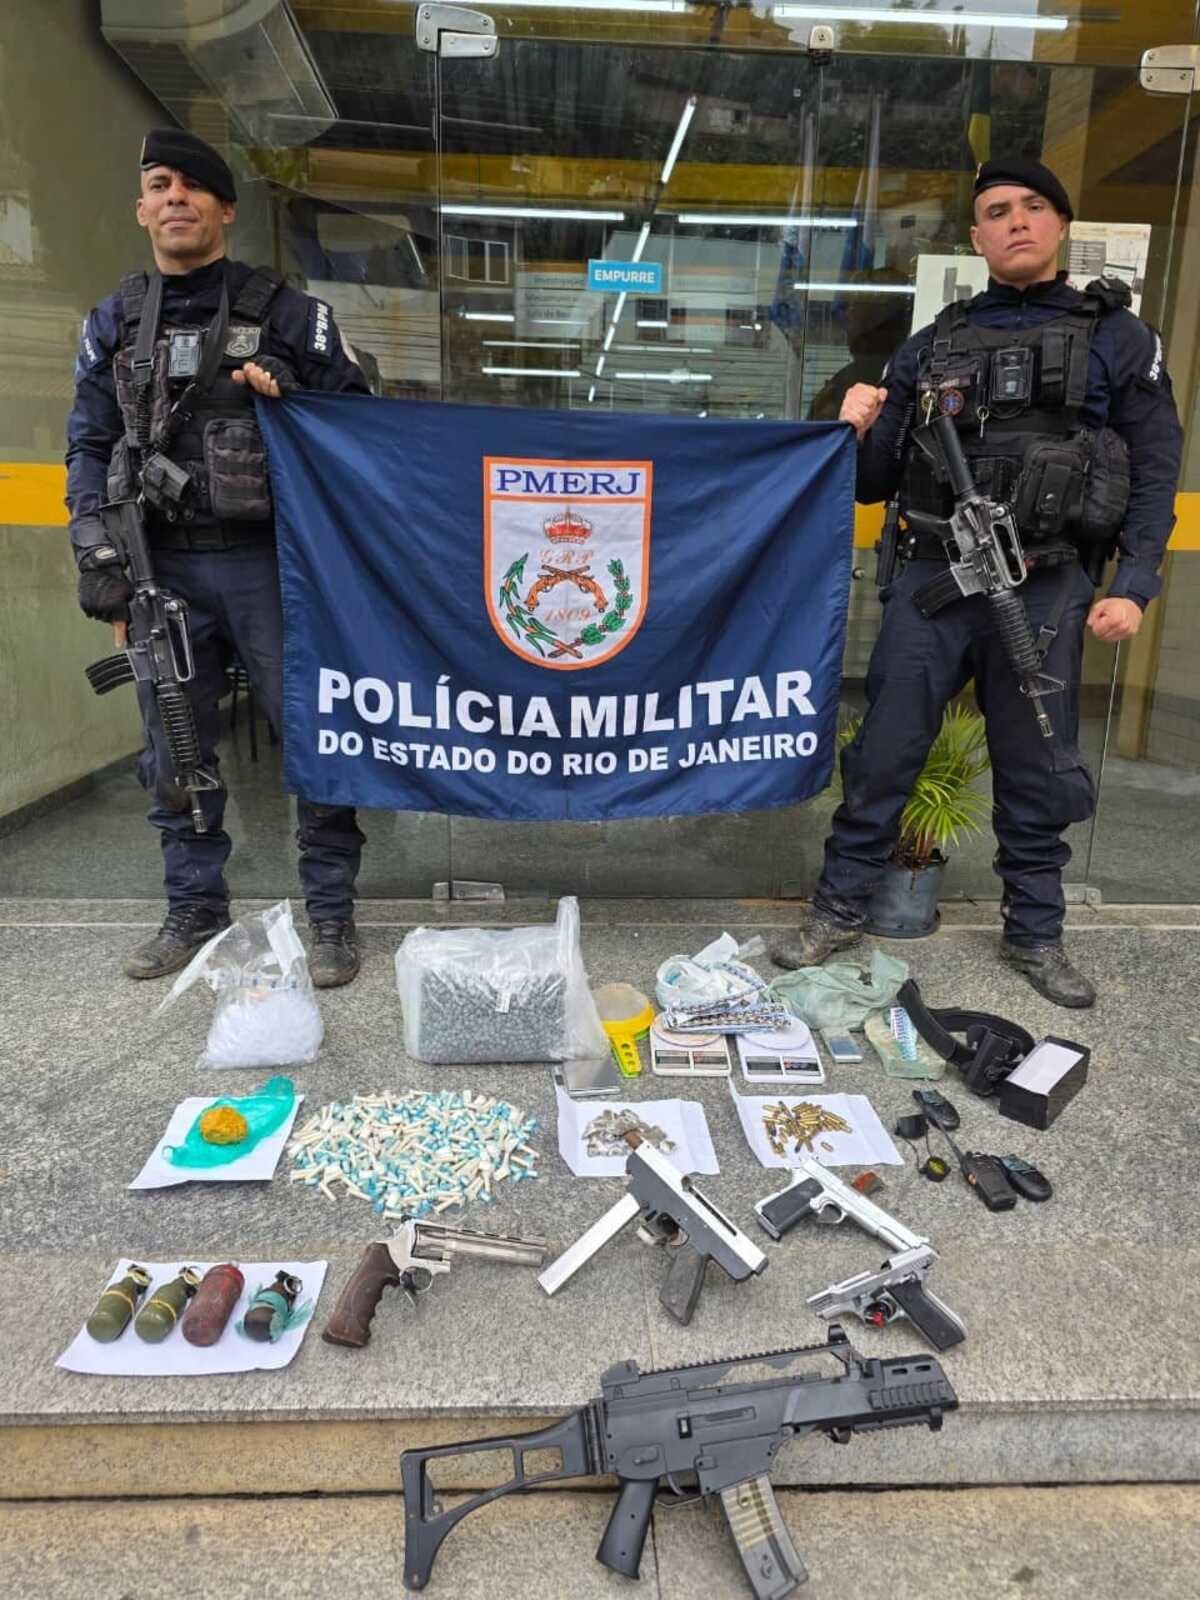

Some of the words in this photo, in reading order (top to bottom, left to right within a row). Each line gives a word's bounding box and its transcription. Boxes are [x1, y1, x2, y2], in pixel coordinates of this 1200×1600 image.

[594, 269, 656, 284] EMPURRE
[496, 469, 641, 495] PMERJ
[543, 606, 593, 623] 1809
[318, 667, 562, 738] POLÍCIA
[570, 669, 817, 739] MILITAR
[318, 729, 364, 756] DO
[371, 736, 496, 774] ESTADO
[507, 749, 552, 776] DO
[562, 750, 617, 777] RIO
[628, 746, 669, 772] DE
[678, 731, 818, 769] JANEIRO
